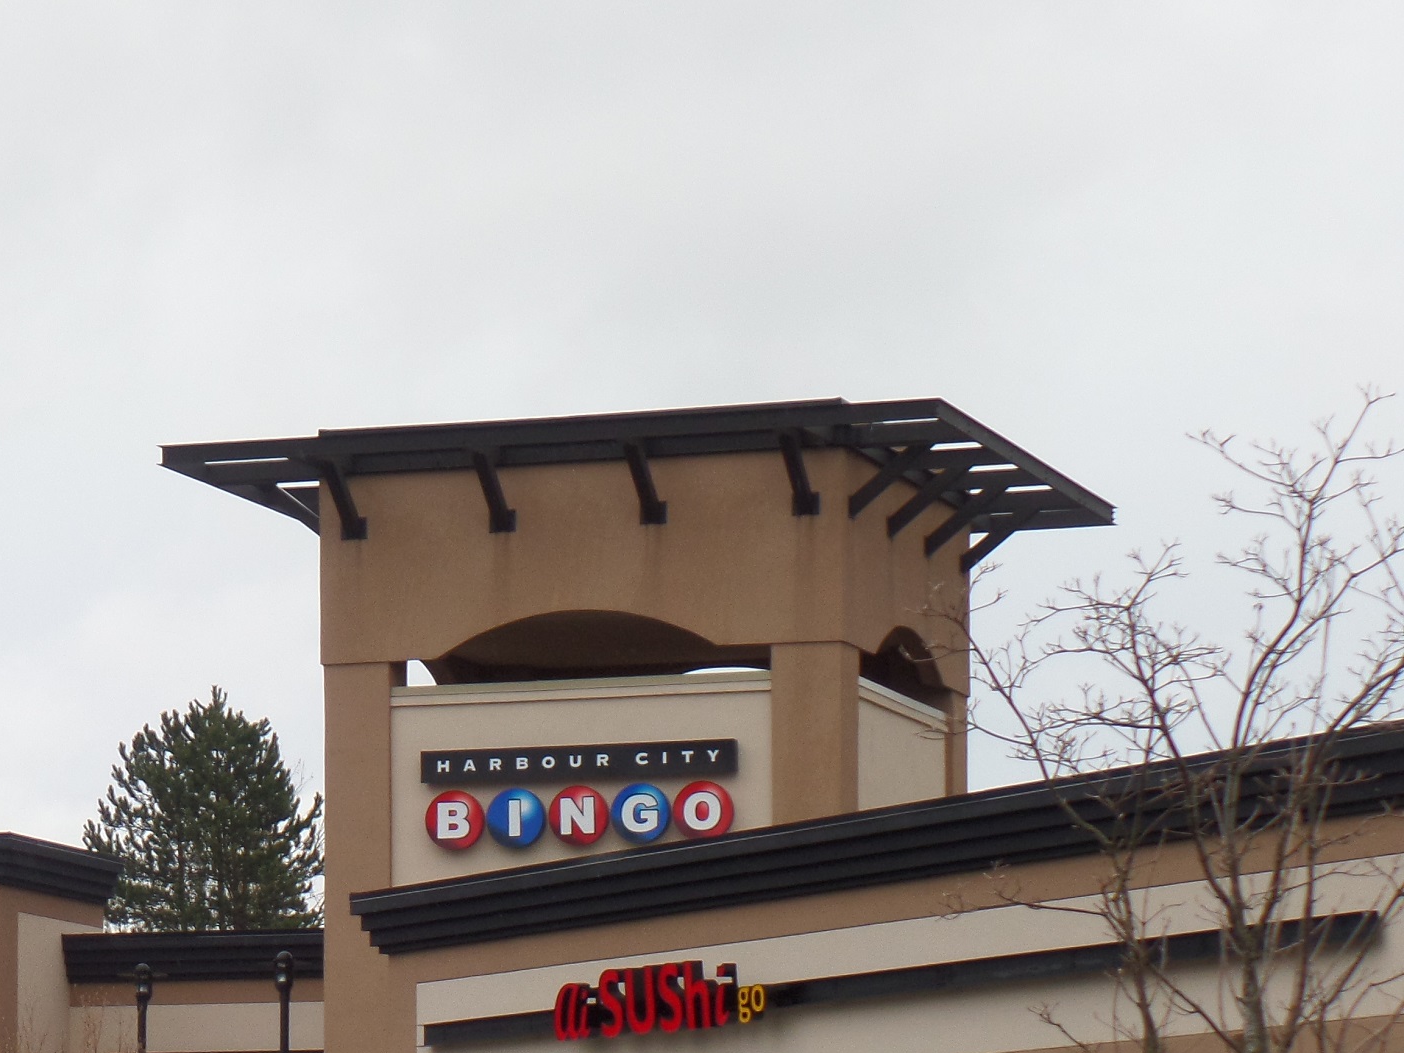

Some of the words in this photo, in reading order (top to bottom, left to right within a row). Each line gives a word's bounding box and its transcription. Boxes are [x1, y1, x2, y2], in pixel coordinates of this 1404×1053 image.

[436, 753, 610, 773] HARBOUR
[634, 749, 720, 765] CITY
[436, 791, 723, 840] BINGO
